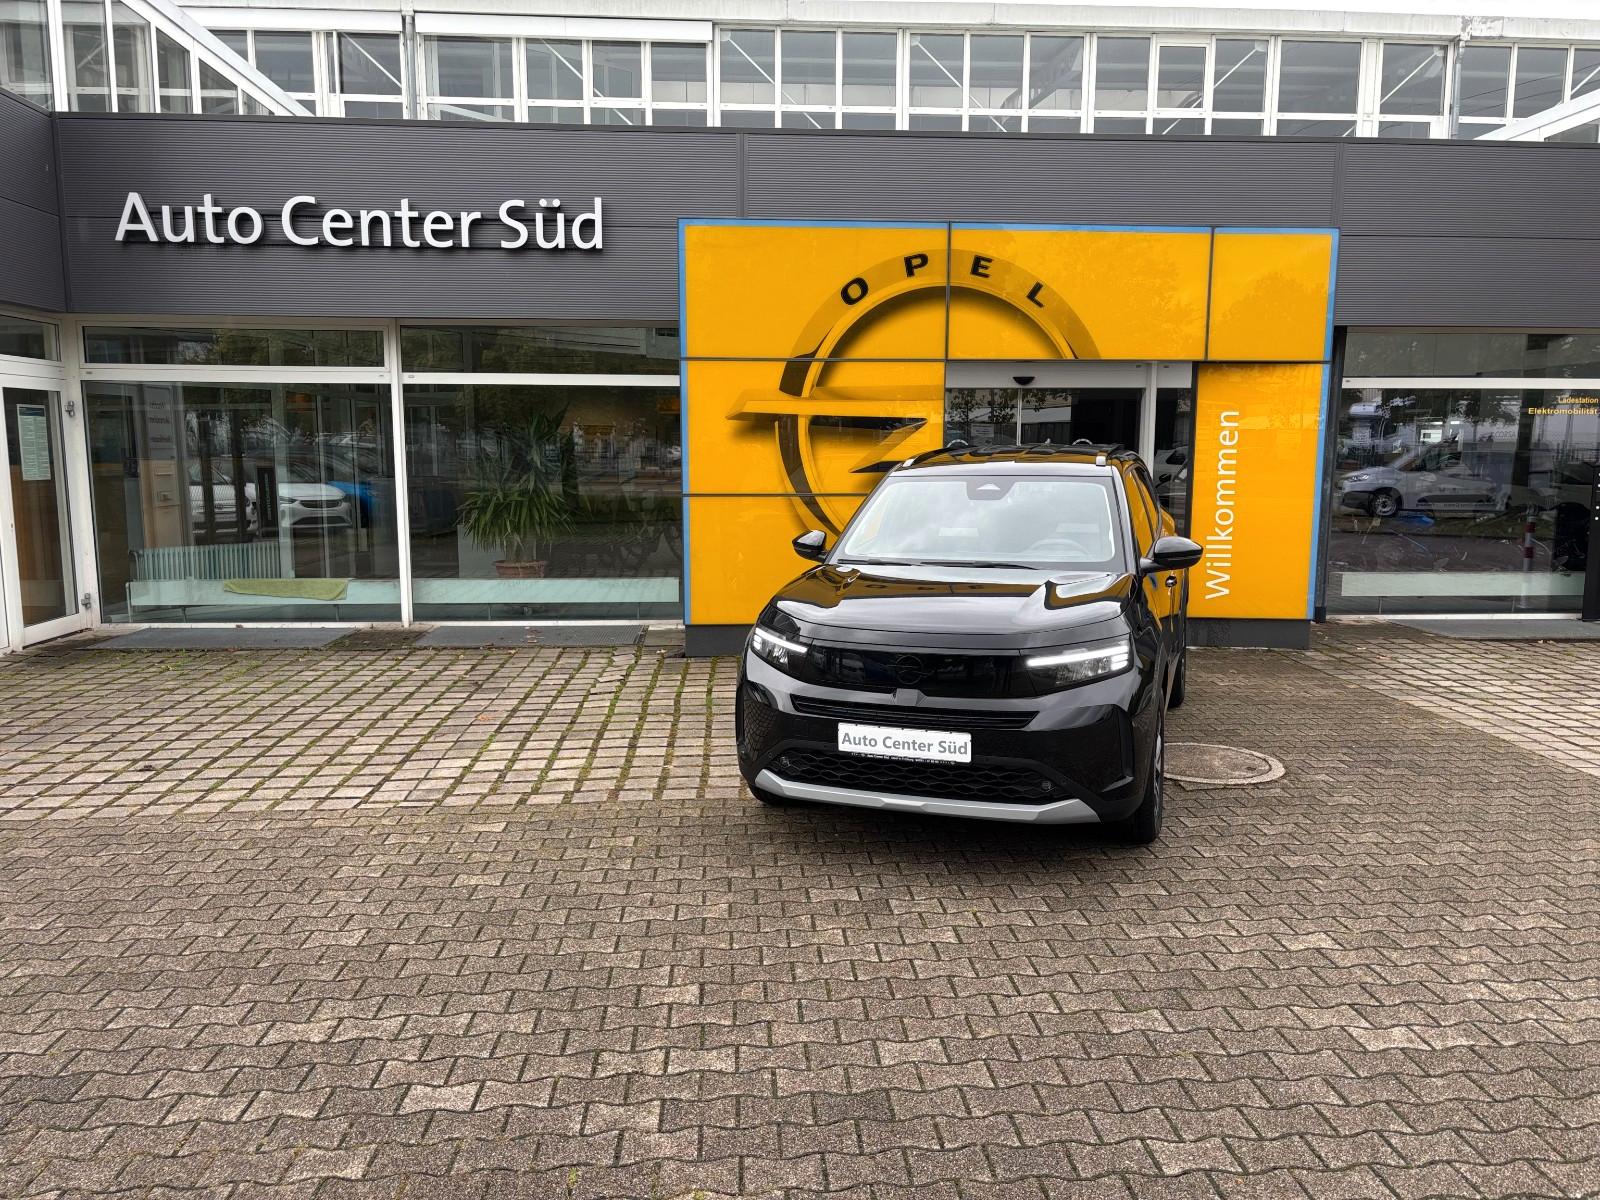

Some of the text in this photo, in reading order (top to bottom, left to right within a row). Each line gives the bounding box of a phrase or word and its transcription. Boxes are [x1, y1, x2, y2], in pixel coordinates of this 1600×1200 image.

[115, 191, 604, 250] Auto Center Süd
[840, 253, 1044, 308] OPEL
[1558, 396, 1599, 404] Ladestation
[1205, 411, 1239, 599] Willkommen
[841, 732, 968, 755] Auto Center Süd
